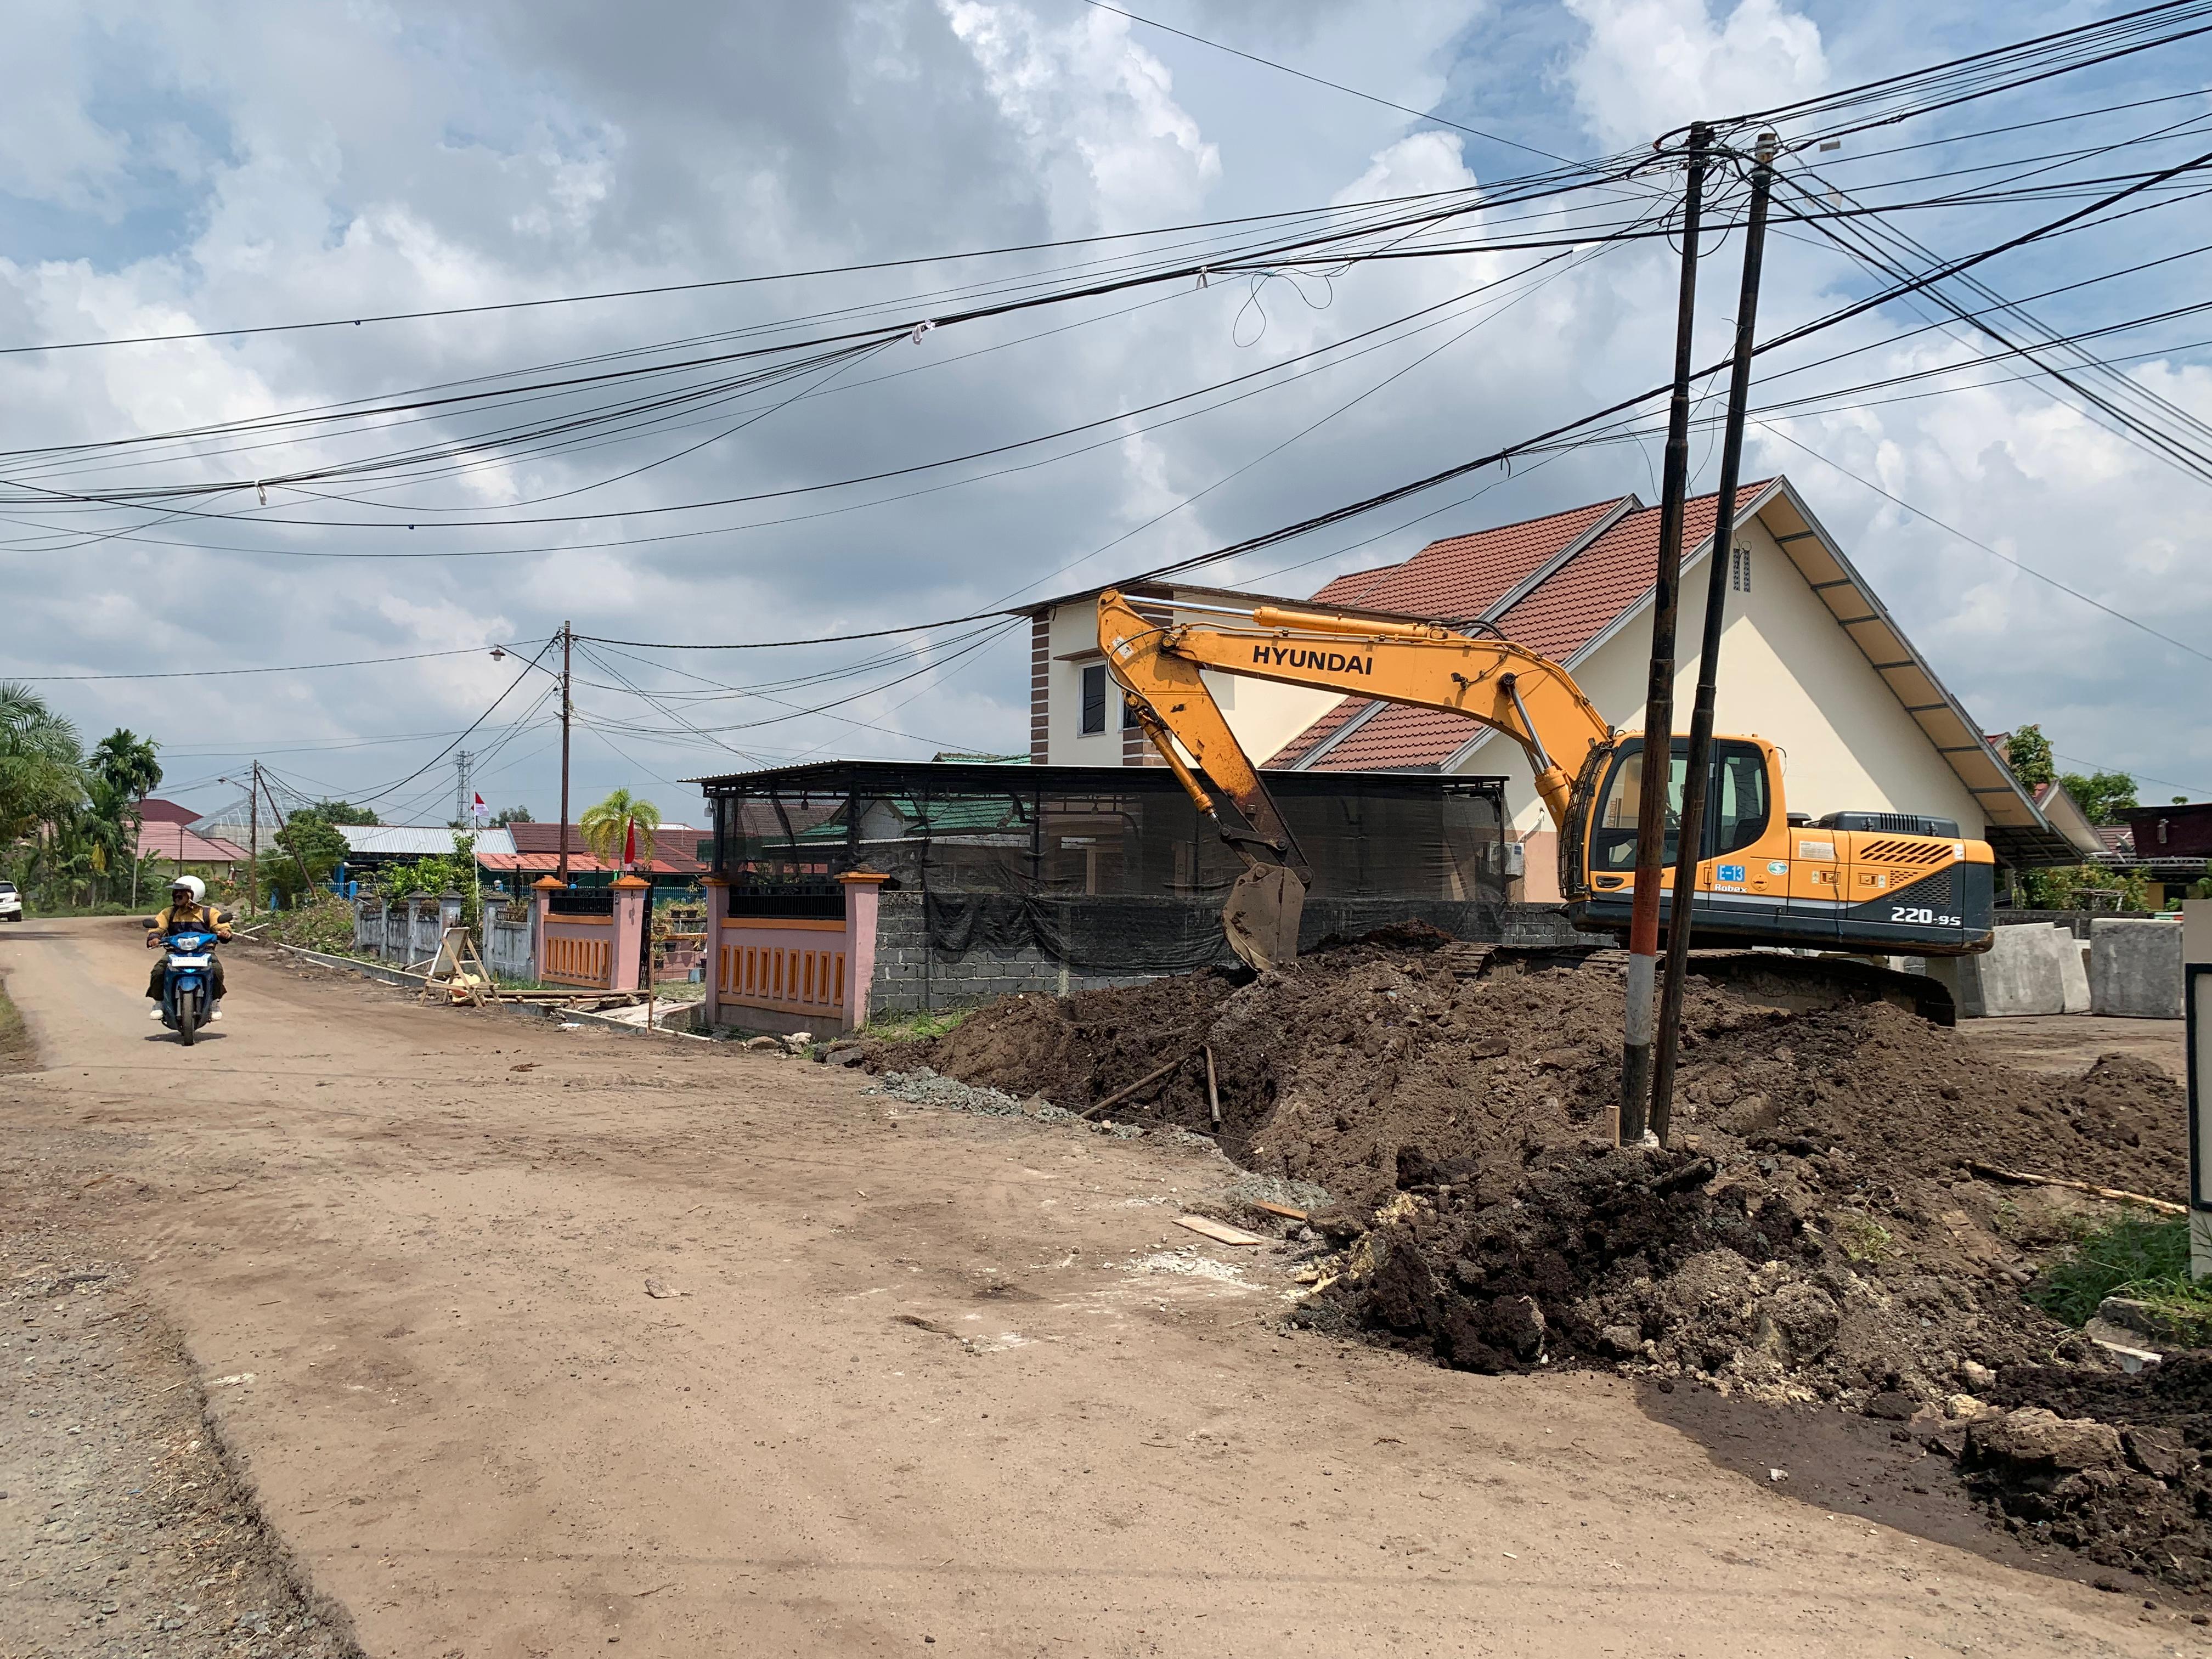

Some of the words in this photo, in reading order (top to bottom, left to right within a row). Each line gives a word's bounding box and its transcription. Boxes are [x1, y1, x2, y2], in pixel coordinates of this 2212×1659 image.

[1252, 645, 1373, 675] HYUNDAI
[1719, 865, 1743, 881] E-13
[1714, 883, 1748, 893] Robex
